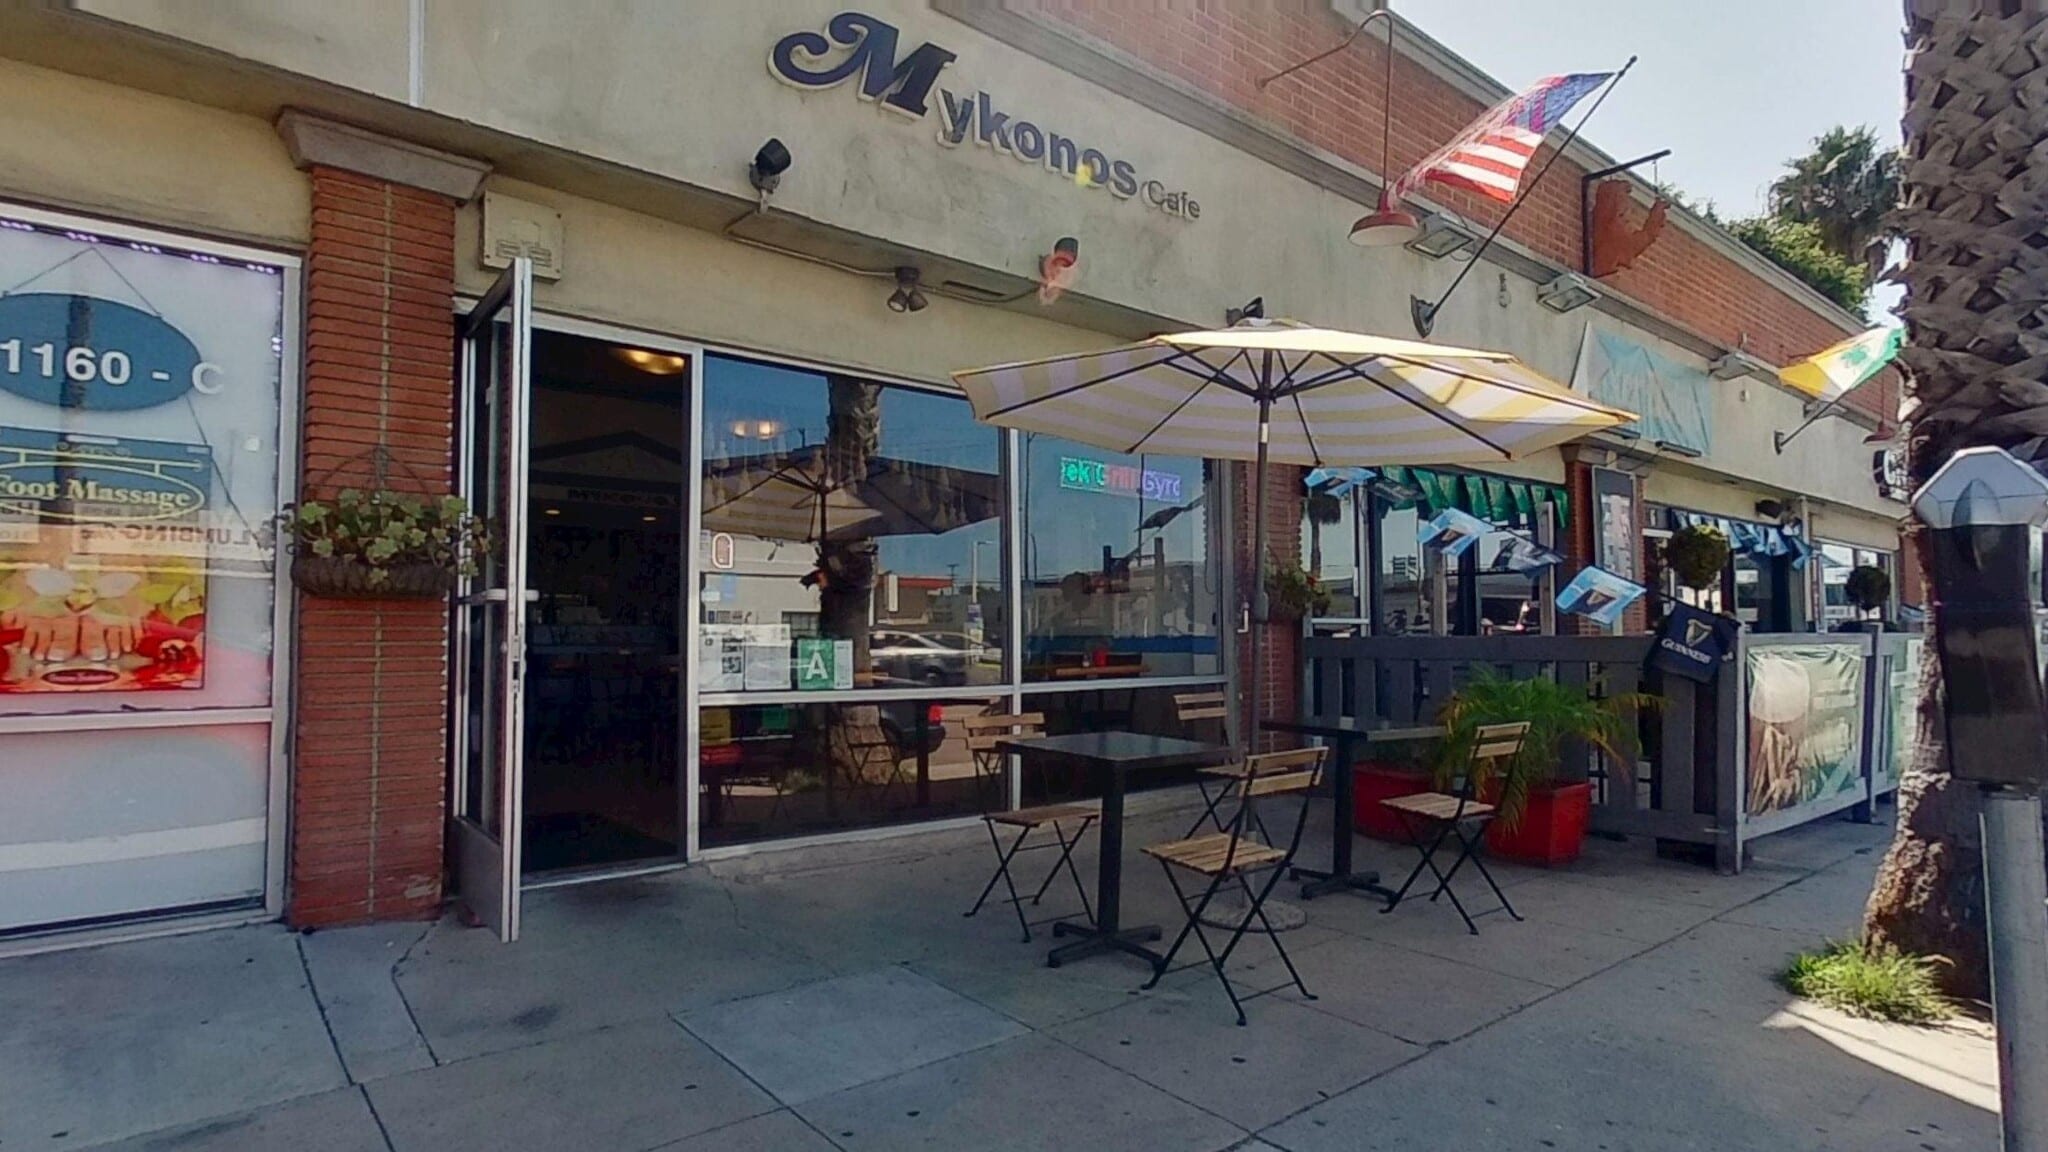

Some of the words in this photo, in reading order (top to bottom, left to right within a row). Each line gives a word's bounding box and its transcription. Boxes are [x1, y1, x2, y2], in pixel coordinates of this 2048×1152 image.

[768, 11, 1138, 201] Mykonos
[1142, 180, 1200, 222] Cafe
[66, 478, 191, 511] Massage
[806, 652, 828, 679] A
